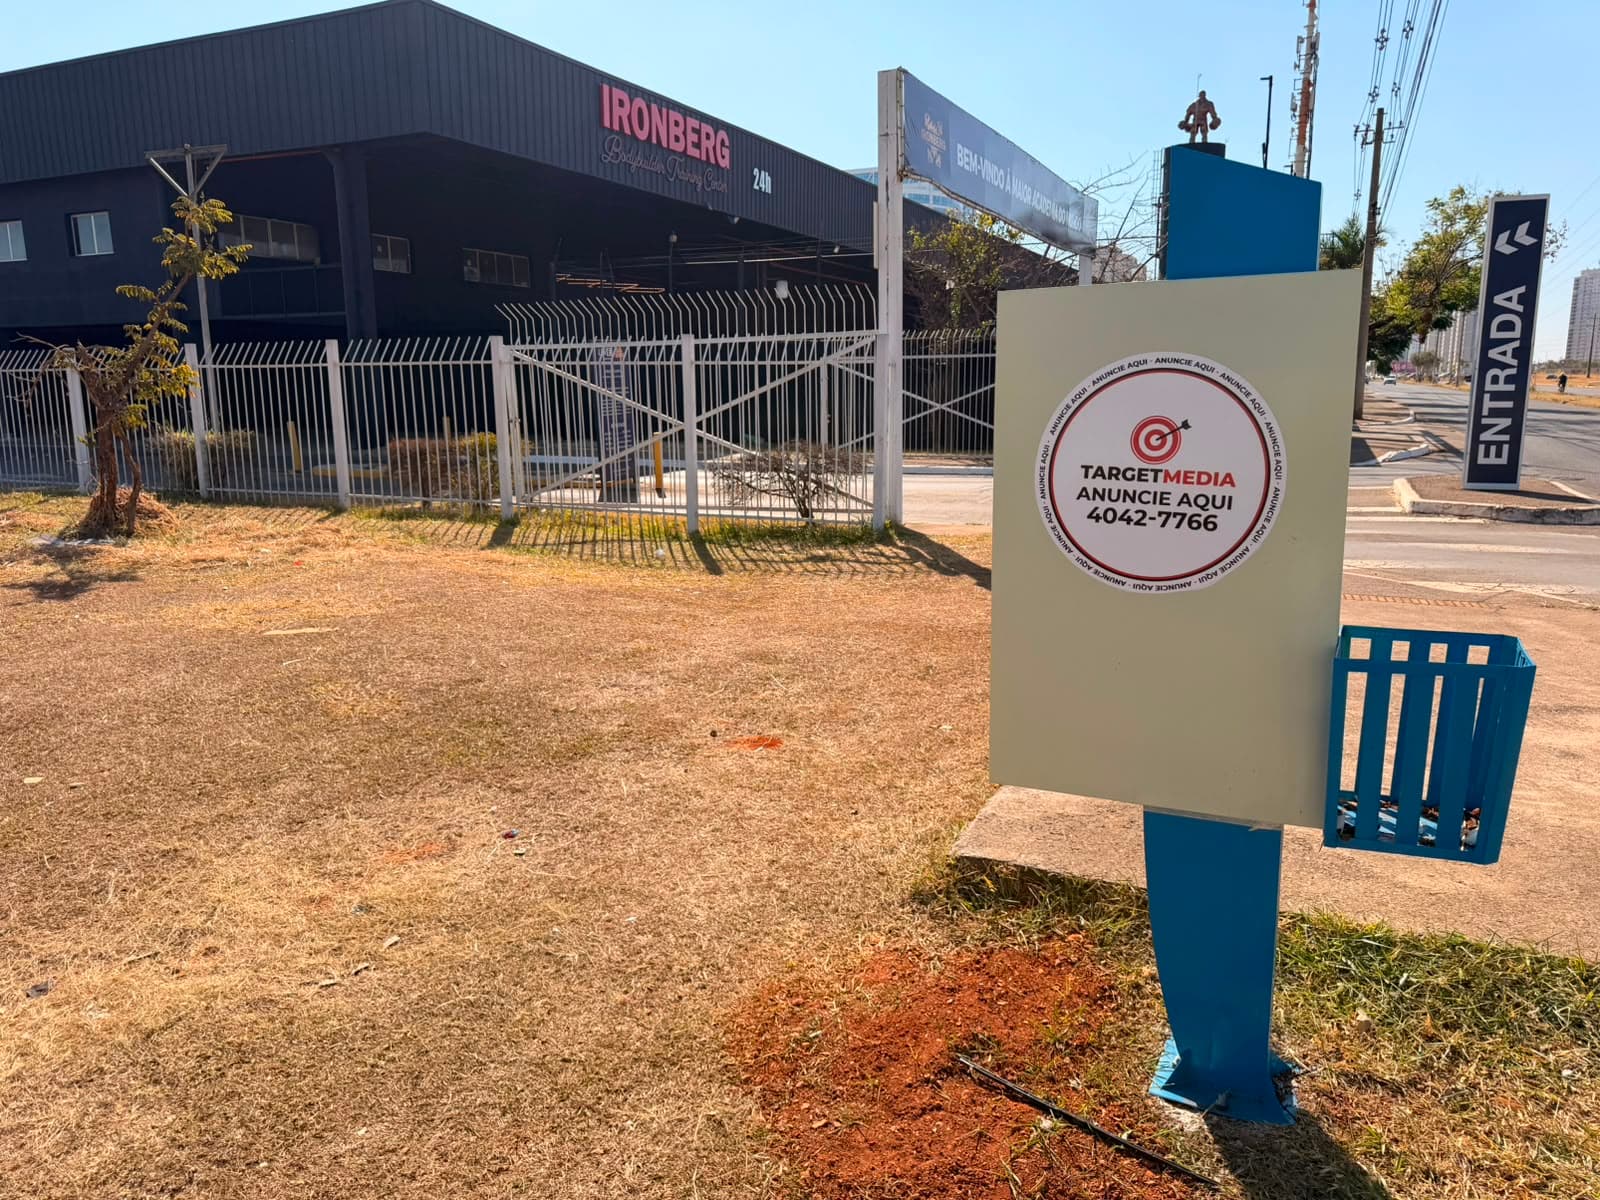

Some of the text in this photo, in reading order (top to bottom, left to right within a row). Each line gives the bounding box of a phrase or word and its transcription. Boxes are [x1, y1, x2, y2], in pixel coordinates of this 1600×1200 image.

[602, 83, 730, 170] IRONBERG
[753, 168, 772, 194] 24h
[957, 143, 1005, 191] BEM-VINDO
[1011, 176, 1031, 205] MAIOR
[1127, 359, 1148, 369] AQUI
[1155, 358, 1193, 367] ANUNCIE
[1194, 361, 1215, 373] AQUI
[1092, 365, 1126, 386] ANUNCIE
[1219, 372, 1252, 399] ANUNCIE
[1476, 285, 1526, 465] ENTRADA
[1071, 387, 1088, 404] AQUI
[1249, 397, 1266, 416] AQUI
[1050, 403, 1072, 435] ANUNCIE
[1264, 421, 1281, 457] ANUNCIE
[1041, 444, 1050, 464] AQUI
[1080, 464, 1237, 489] TARGETMEDIA
[1274, 459, 1282, 480] AQUI
[1076, 486, 1233, 512] ANUNCIE AQUI
[1263, 486, 1280, 523] ANUNCIE
[1043, 505, 1053, 524] AQUI
[1087, 506, 1219, 532] 4042-7766
[1051, 525, 1073, 554] ANUNCIE
[1251, 524, 1267, 544] AQUI
[1075, 556, 1093, 571] AQUI
[1219, 546, 1250, 573] ANUNCIE
[1093, 568, 1127, 587] ANUNCIE
[1132, 583, 1153, 592] AQUI
[1155, 581, 1192, 592] ANUNCIE
[1198, 570, 1218, 584] AQUI
